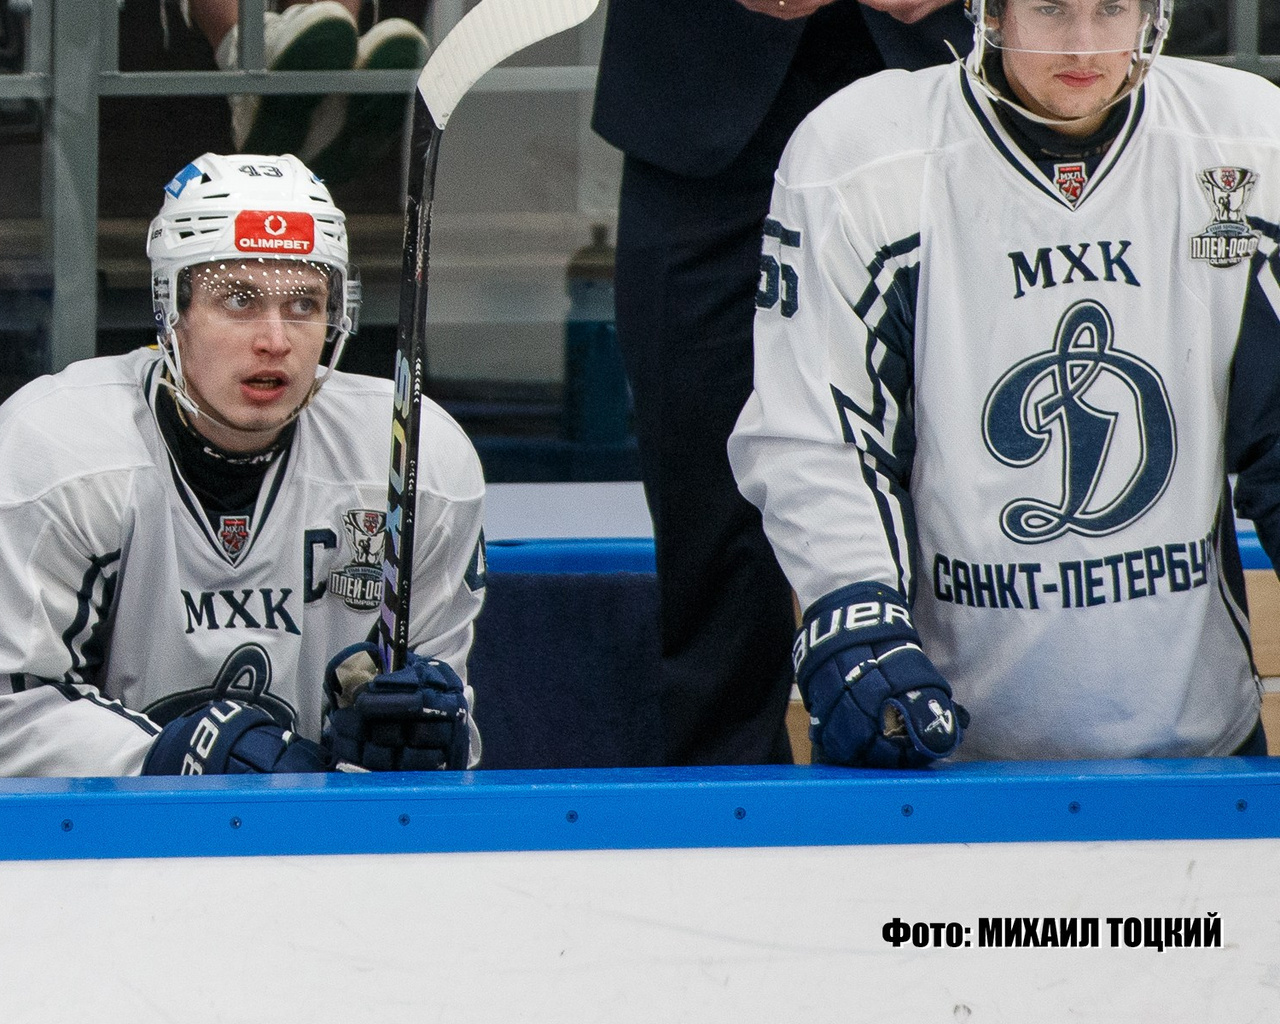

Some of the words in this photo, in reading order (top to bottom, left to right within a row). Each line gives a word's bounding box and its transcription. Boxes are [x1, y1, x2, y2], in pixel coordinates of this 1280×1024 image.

[238, 165, 283, 178] 43
[239, 237, 310, 251] OLIMPBET
[1192, 236, 1258, 259] ПЛЕЙ-ОФФ
[1007, 240, 1141, 299] МХК
[933, 534, 1208, 609] САНКТ-ПЕТЕРБУ
[181, 587, 302, 636] МХК
